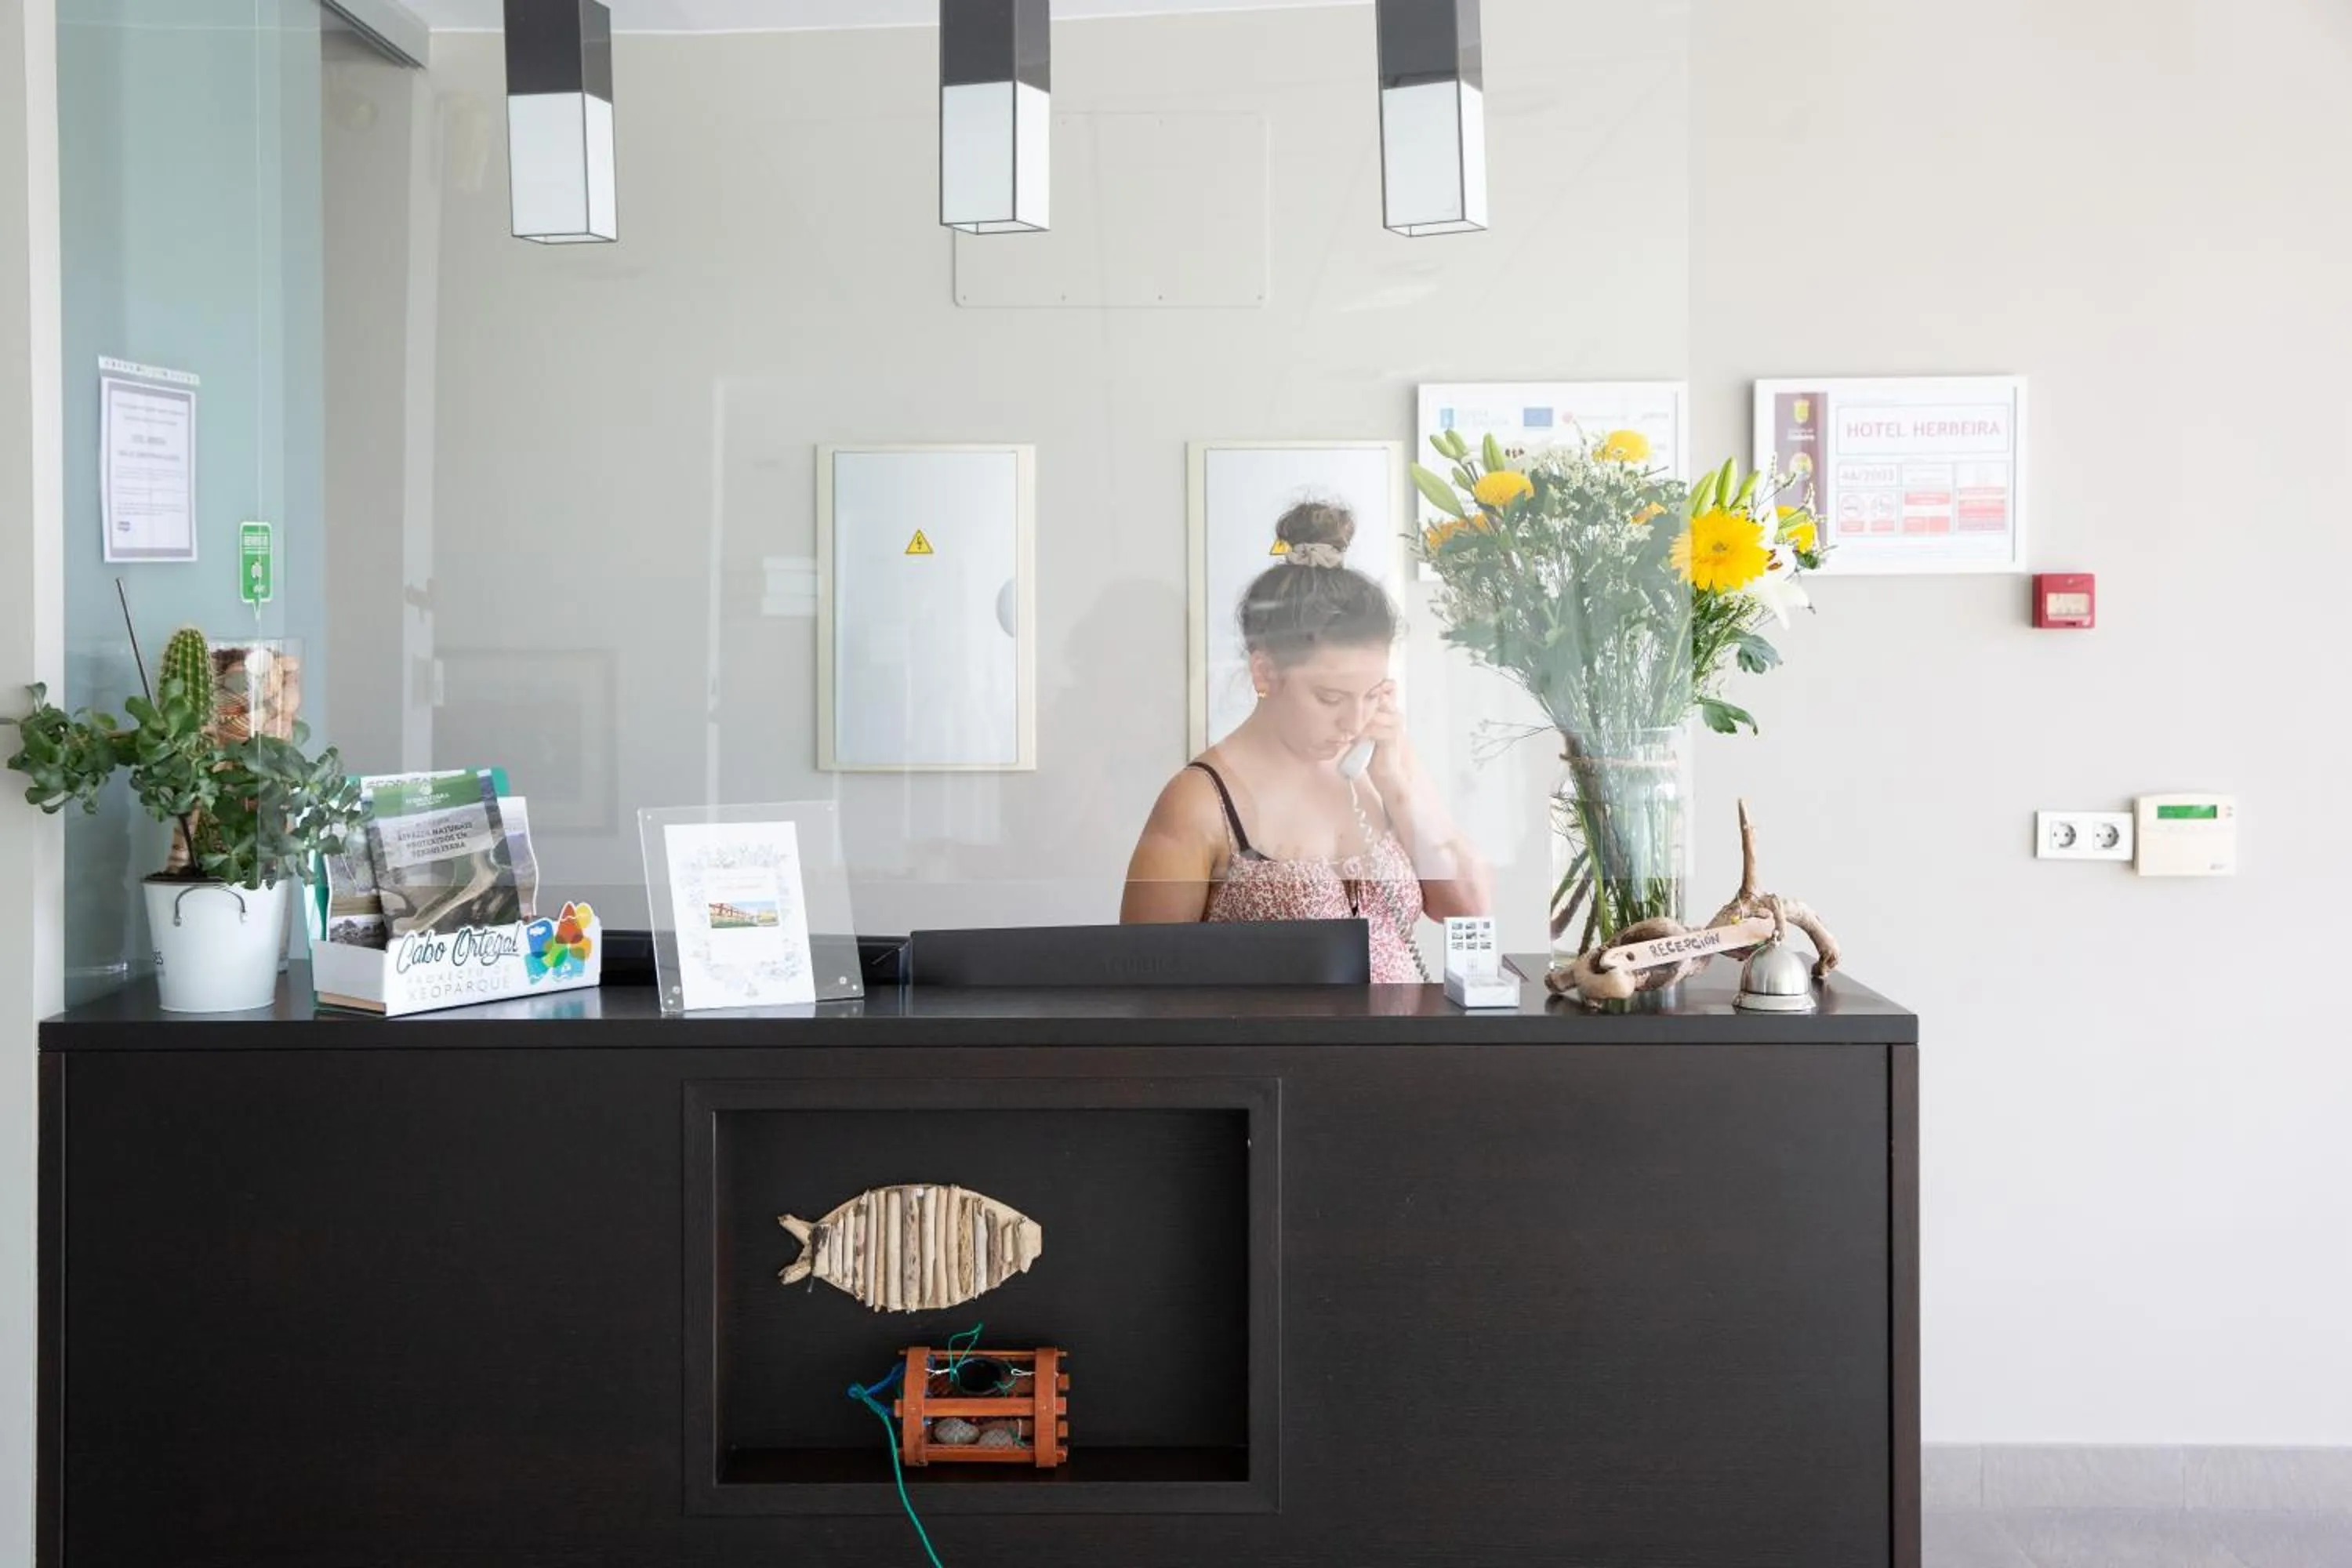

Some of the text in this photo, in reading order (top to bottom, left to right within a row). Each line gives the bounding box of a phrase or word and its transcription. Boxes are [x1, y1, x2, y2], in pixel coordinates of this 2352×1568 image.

[1846, 420, 2001, 439] HOTEL HERBEIRA
[396, 922, 520, 975] Cabo Ortegal
[406, 975, 511, 1001] XEOPARQUE
